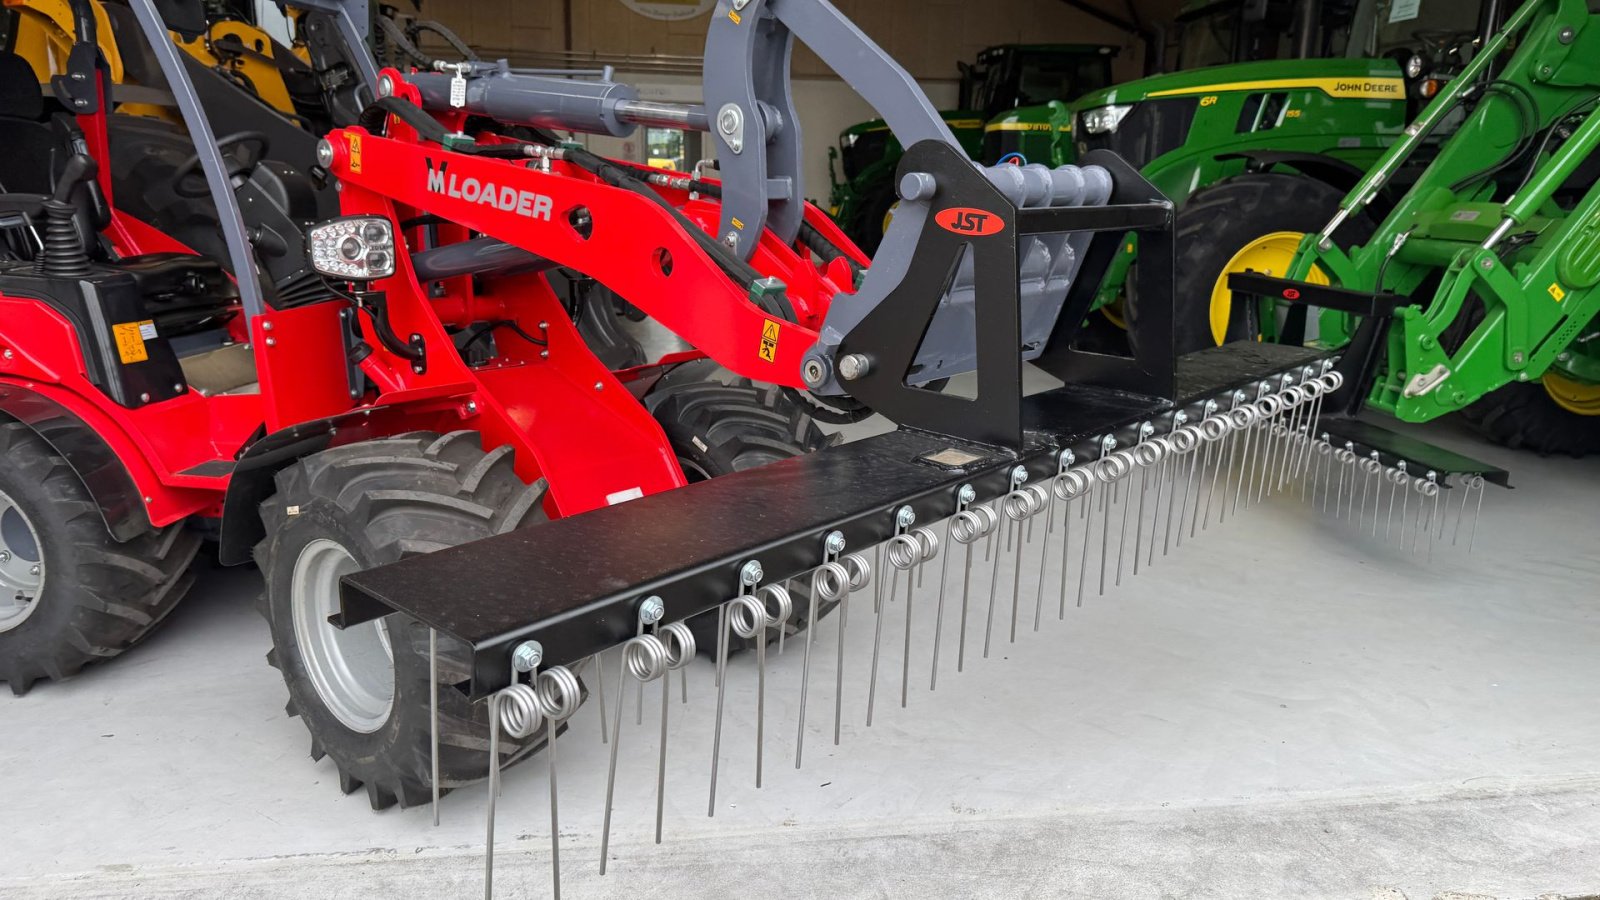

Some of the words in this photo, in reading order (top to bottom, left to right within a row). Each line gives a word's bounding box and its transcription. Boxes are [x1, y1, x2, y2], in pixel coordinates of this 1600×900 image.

[1335, 82, 1361, 92] JOHN
[1364, 83, 1398, 92] DEERE
[1200, 96, 1218, 106] 6R
[951, 211, 989, 233] JST
